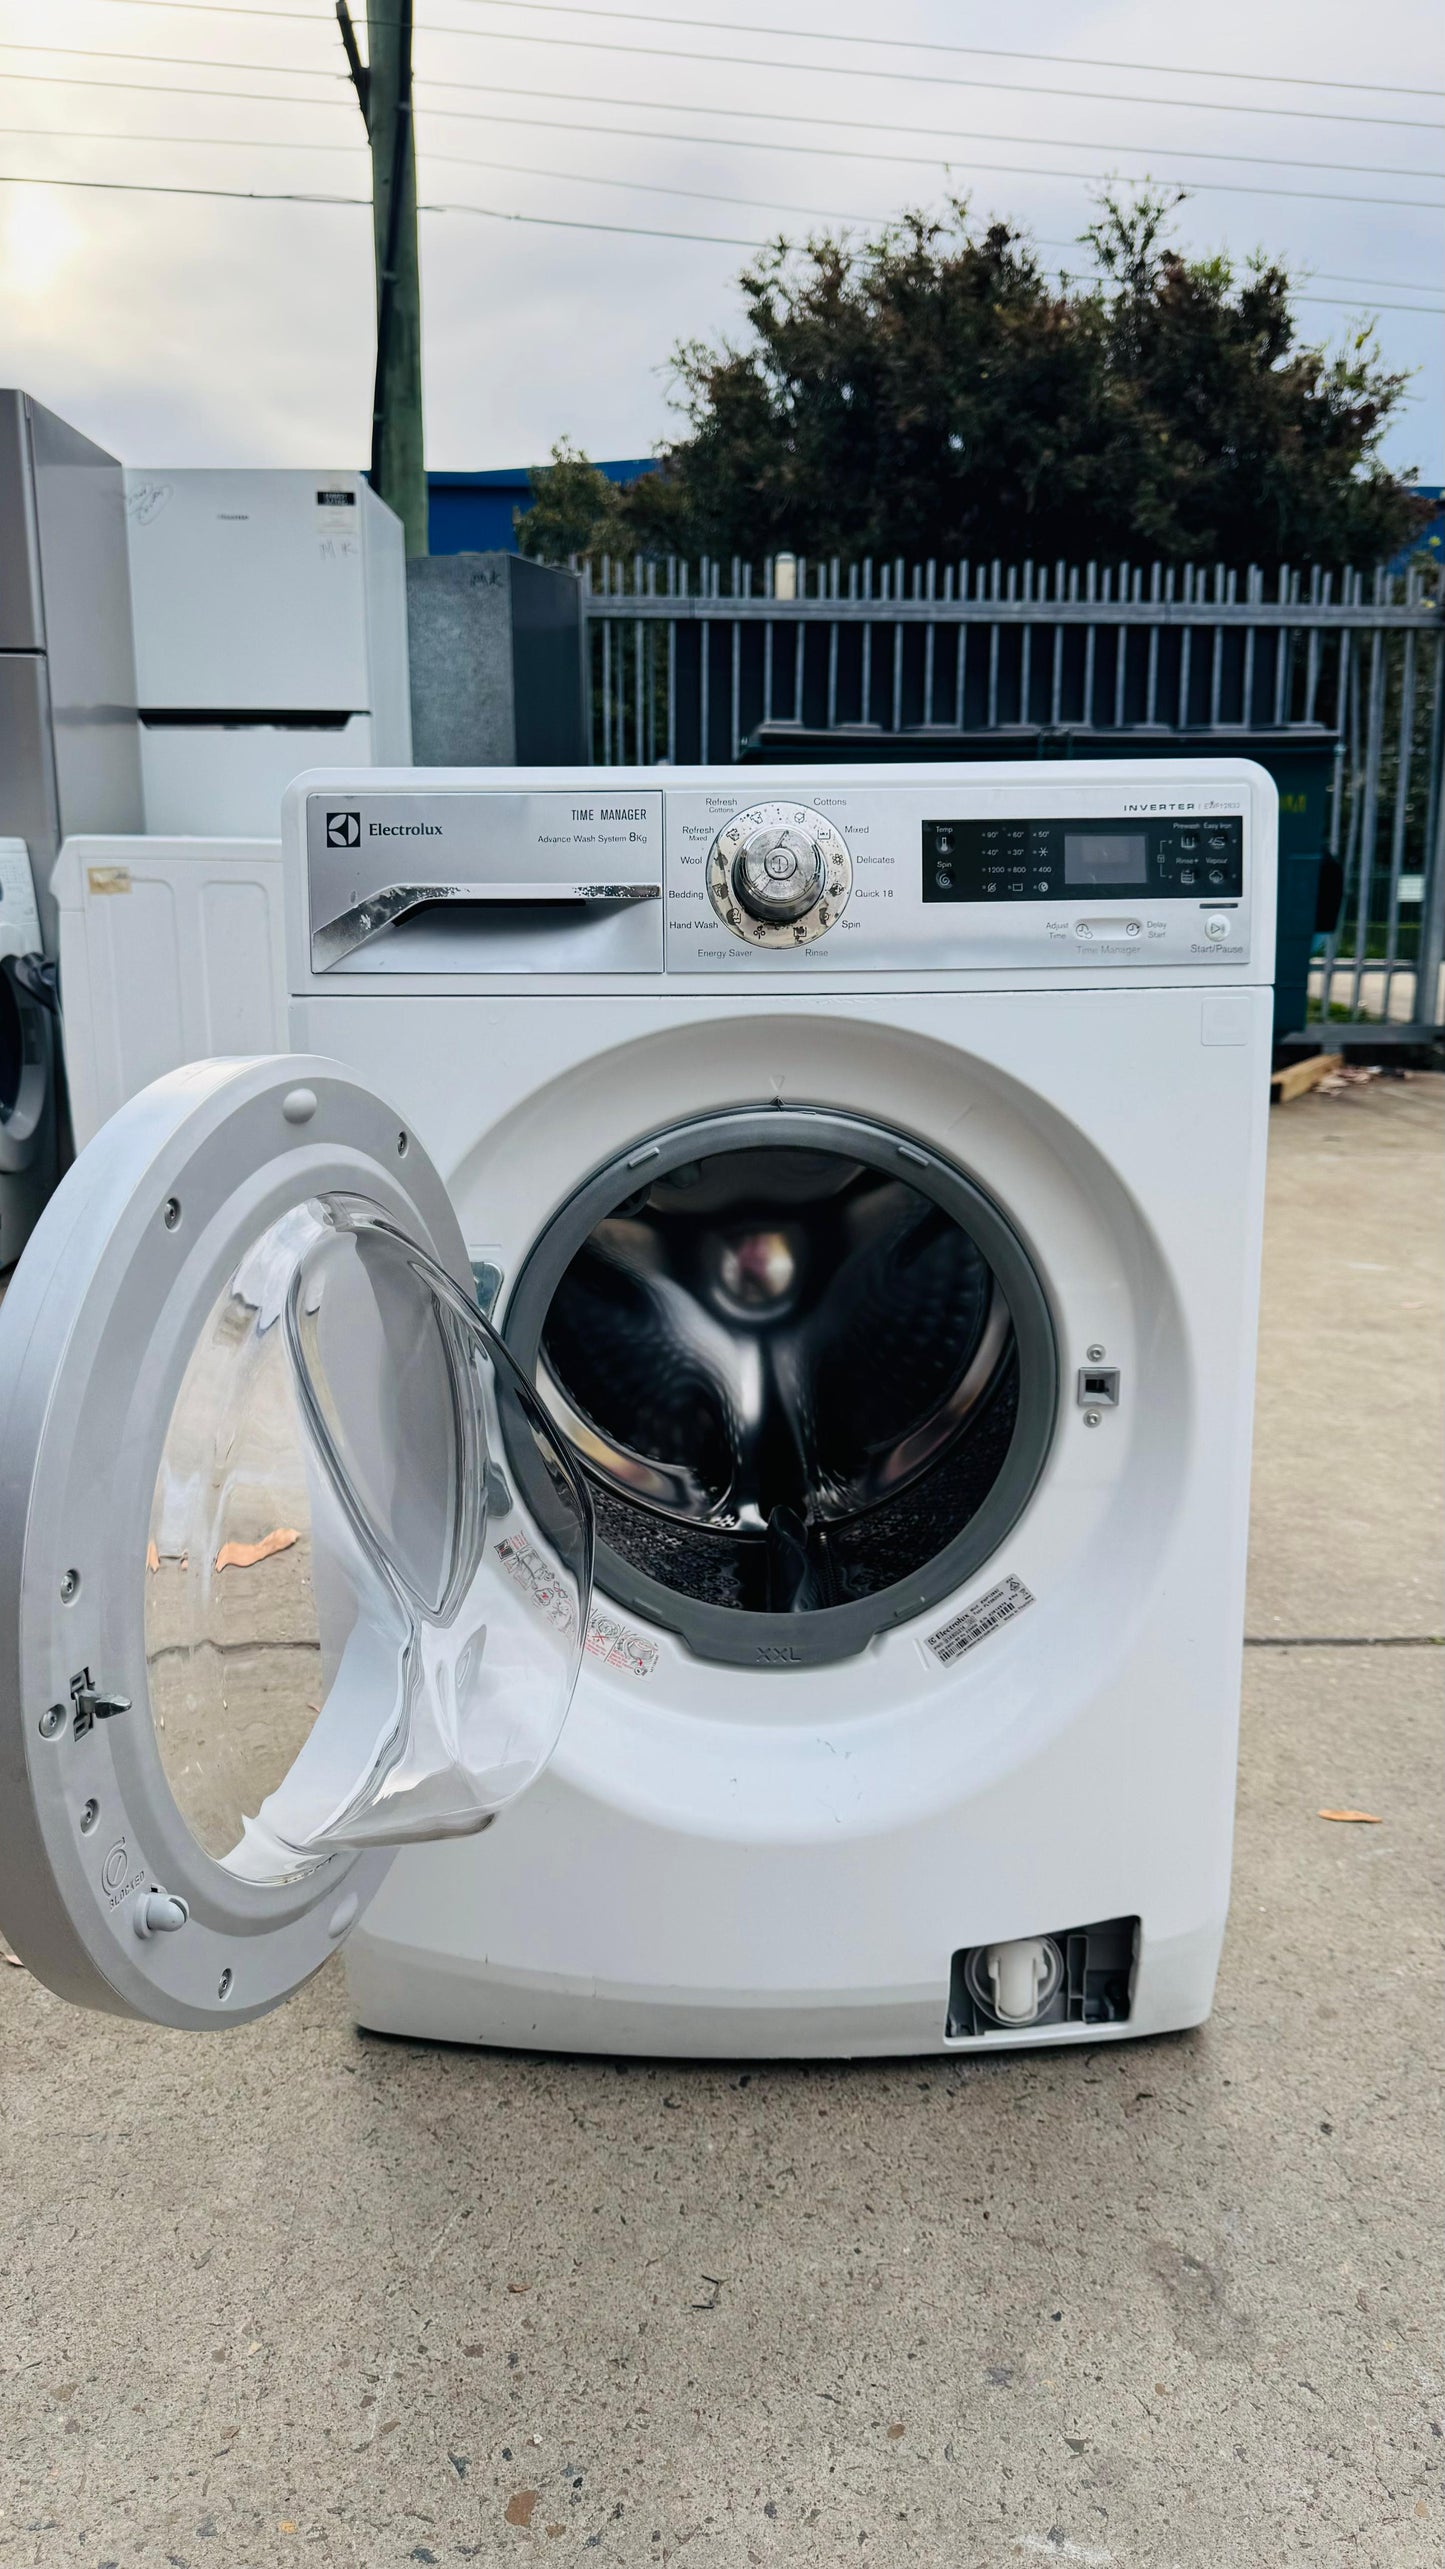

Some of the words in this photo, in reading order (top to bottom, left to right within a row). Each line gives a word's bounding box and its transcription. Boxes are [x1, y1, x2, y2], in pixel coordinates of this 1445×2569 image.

[814, 798, 847, 806] Cottons
[1124, 803, 1195, 811] INVERTER
[572, 809, 594, 821] TIME
[601, 809, 647, 820] MANAGER
[369, 823, 443, 836] Electrolux
[682, 826, 714, 834] Refresh
[844, 825, 869, 834] Mixed
[538, 835, 571, 843] Advance
[598, 835, 627, 844] System
[629, 832, 647, 843] 8Kg
[680, 856, 702, 864] Wool
[856, 856, 895, 864] Delicates
[937, 861, 952, 869] Spin
[668, 890, 704, 899] Bedding
[855, 889, 880, 898] Quick
[883, 890, 894, 898] 18
[669, 921, 692, 929] Hand
[694, 921, 719, 929] Wash
[841, 920, 861, 929] Spin
[1147, 921, 1167, 929] Delay
[805, 948, 828, 957] Rinse
[1190, 943, 1244, 954] Start/Pause
[697, 949, 727, 959] Energy
[728, 949, 753, 957] Saver
[935, 1614, 970, 1640] Electrolux
[756, 1647, 802, 1662] XXL
[110, 1871, 145, 1911] BLOCKED
